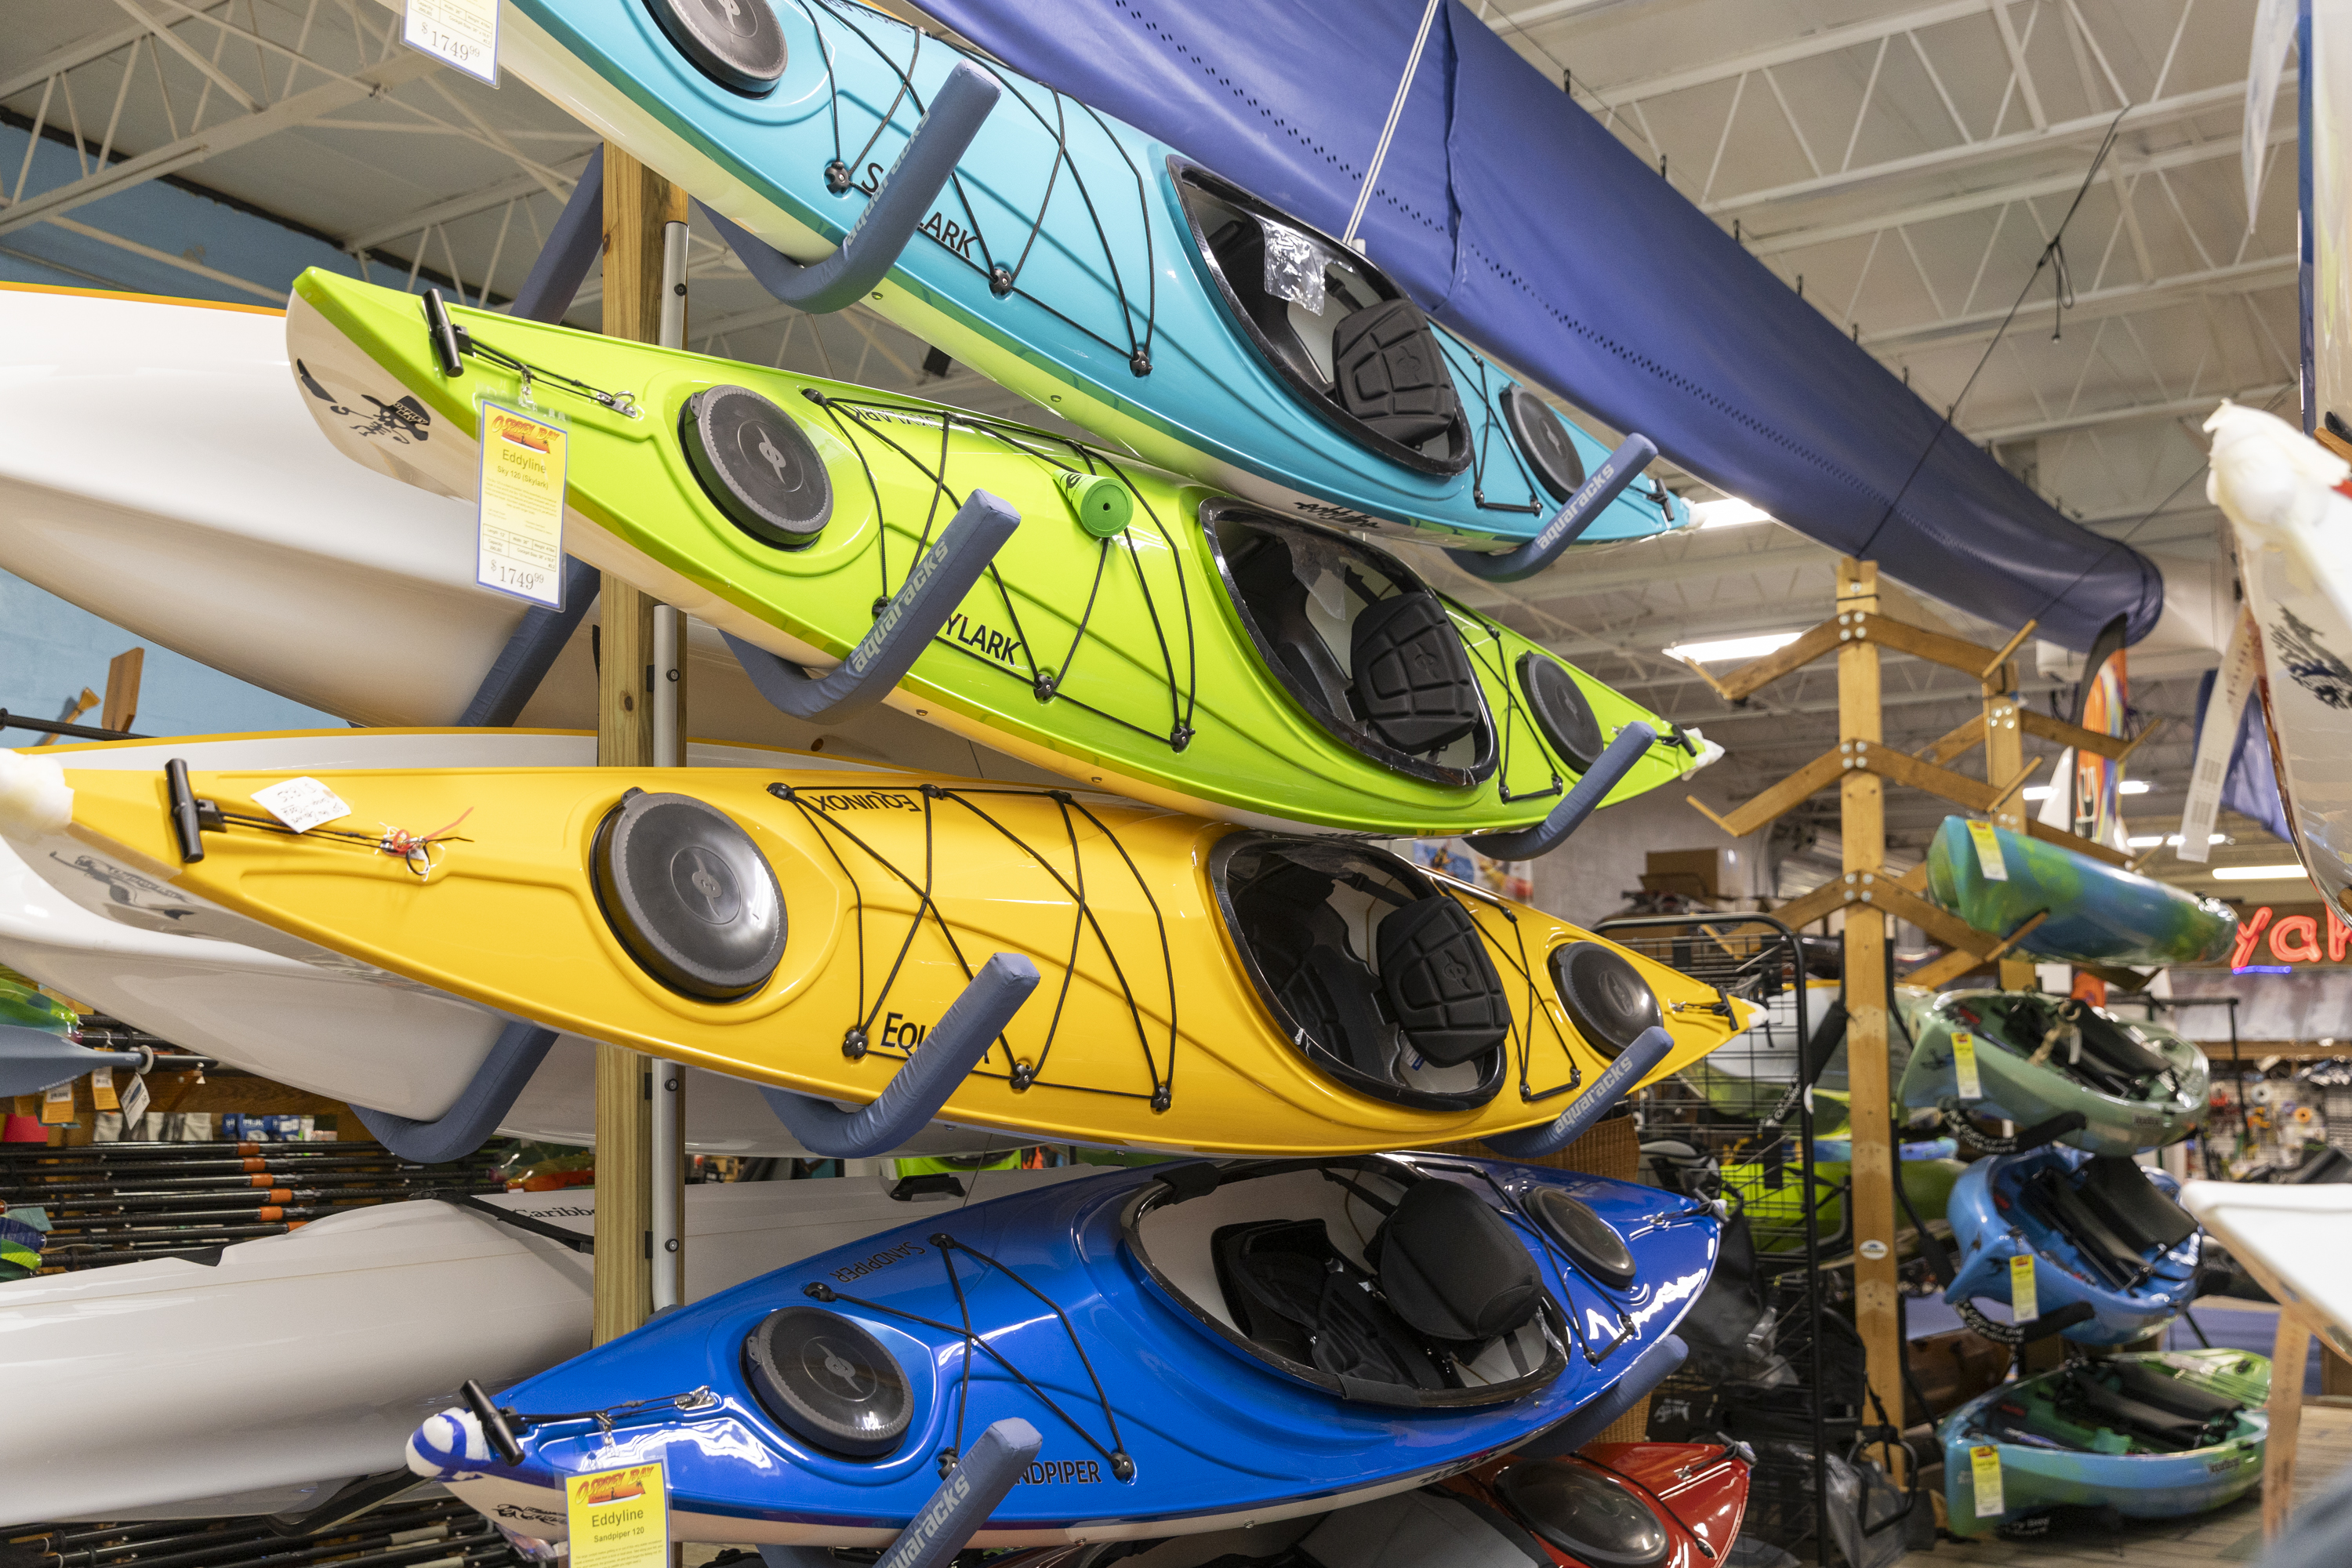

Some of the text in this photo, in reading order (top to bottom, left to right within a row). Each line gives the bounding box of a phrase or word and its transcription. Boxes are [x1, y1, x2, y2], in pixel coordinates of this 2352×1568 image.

[491, 415, 561, 441] OSPREY BAY
[502, 448, 546, 474] Eddyline
[497, 465, 550, 491] Sky 120 (Skylark)
[1537, 463, 1615, 550] aquaracks
[851, 541, 949, 673] aquaracks
[946, 612, 1022, 666] YLARK
[1552, 1056, 1634, 1134] aquaracks
[575, 1466, 655, 1505] OSPREY BAY
[1015, 1460, 1102, 1485] NDPIPER
[591, 1508, 644, 1528] Eddyline
[593, 1526, 644, 1544] Sandpiper 120
